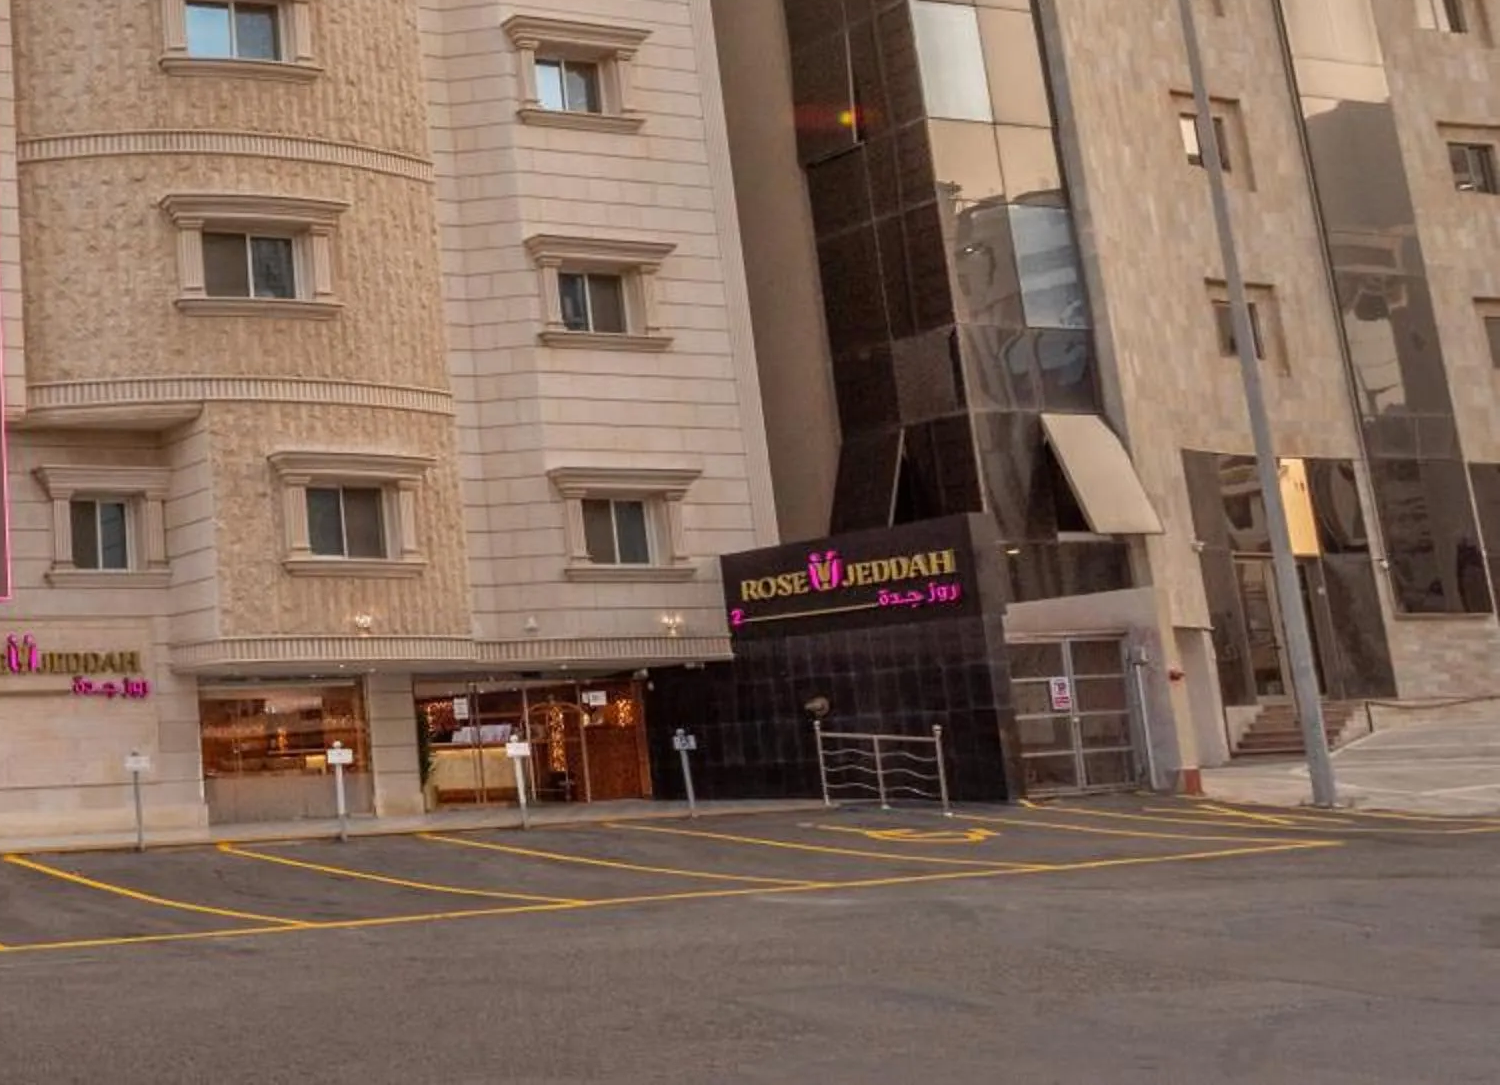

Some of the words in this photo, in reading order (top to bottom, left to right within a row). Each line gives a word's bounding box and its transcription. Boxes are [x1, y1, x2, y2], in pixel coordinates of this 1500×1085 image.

[740, 570, 807, 602] ROSE
[841, 549, 956, 587] JEDDAH
[878, 589, 923, 608] جدة
[927, 582, 961, 603] روز
[731, 608, 744, 625] 2
[37, 651, 141, 674] JEDDAH
